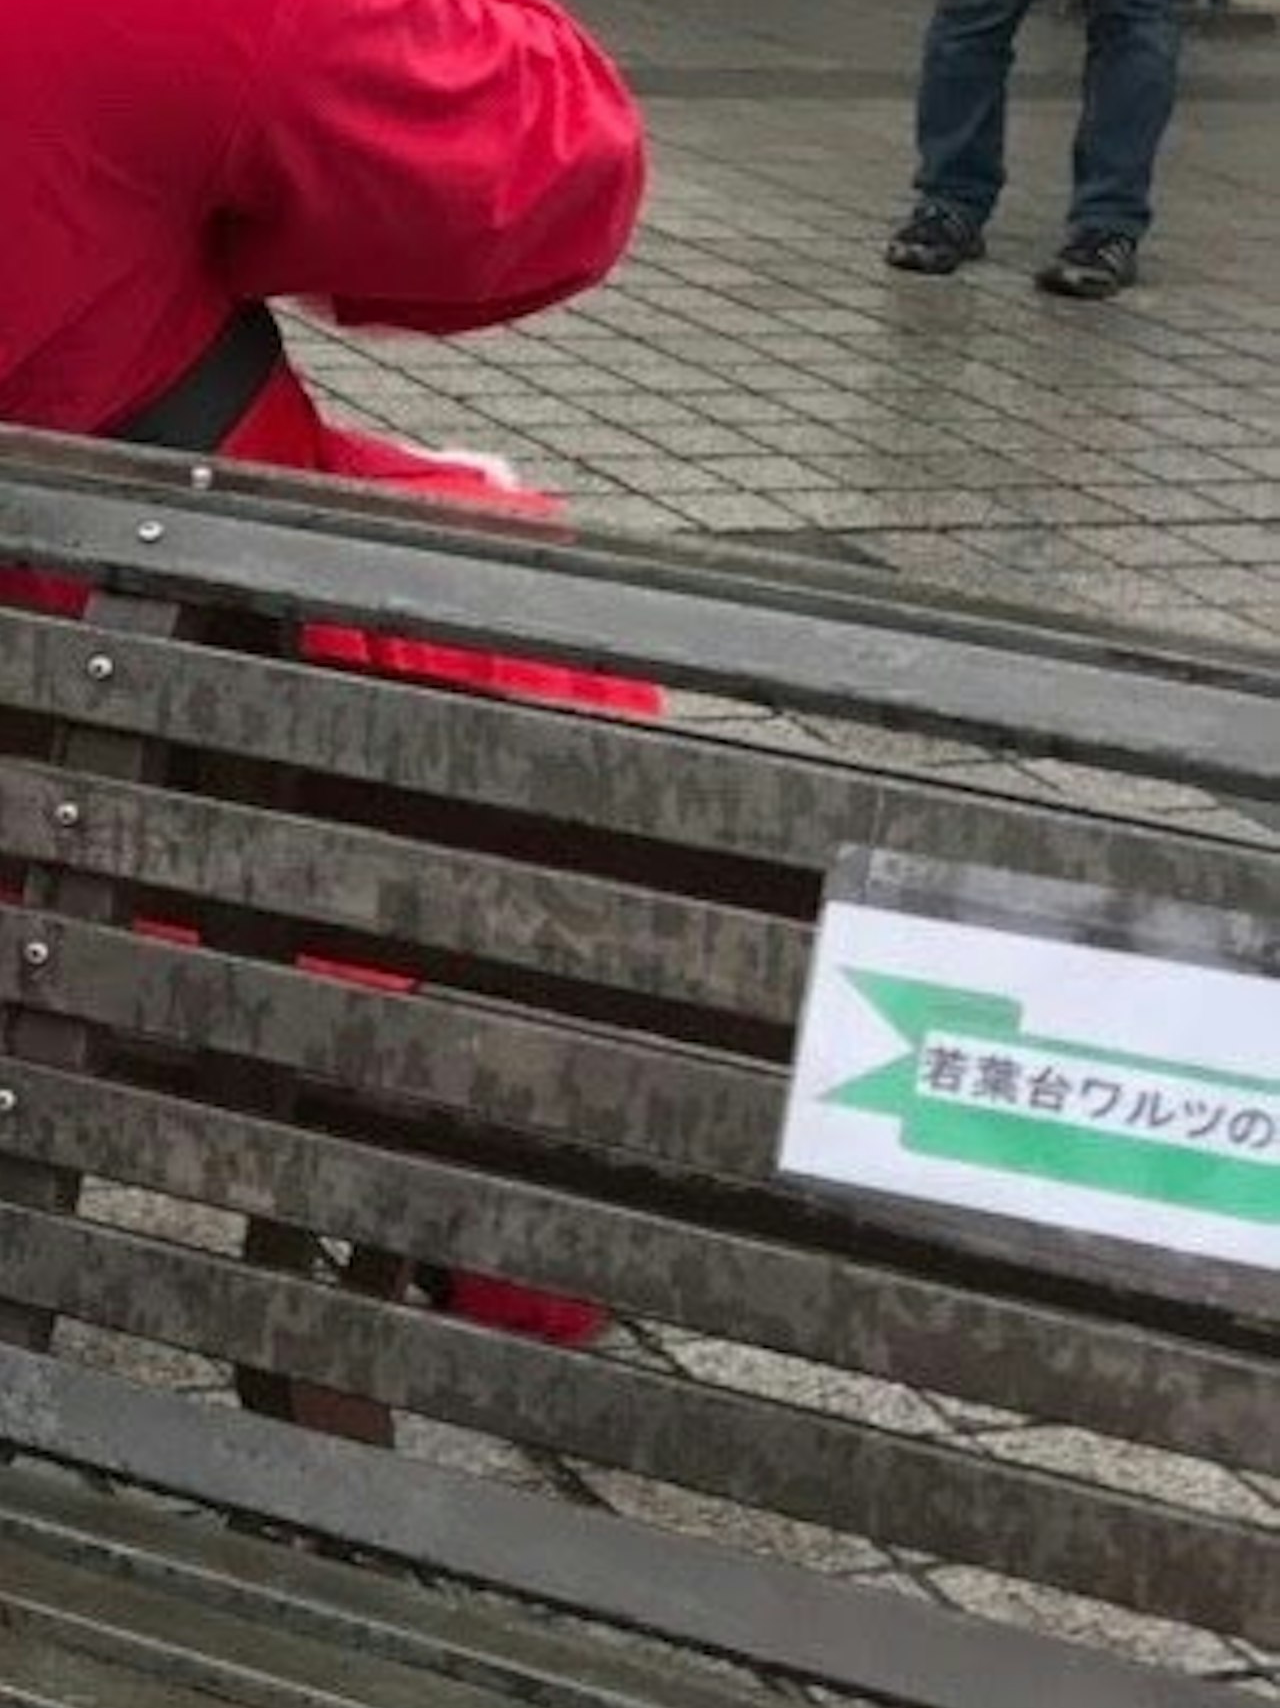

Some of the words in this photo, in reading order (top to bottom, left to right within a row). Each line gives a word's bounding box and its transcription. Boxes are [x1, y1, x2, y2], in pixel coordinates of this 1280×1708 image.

[925, 1046, 1276, 1149] 若葉台ワルツの
